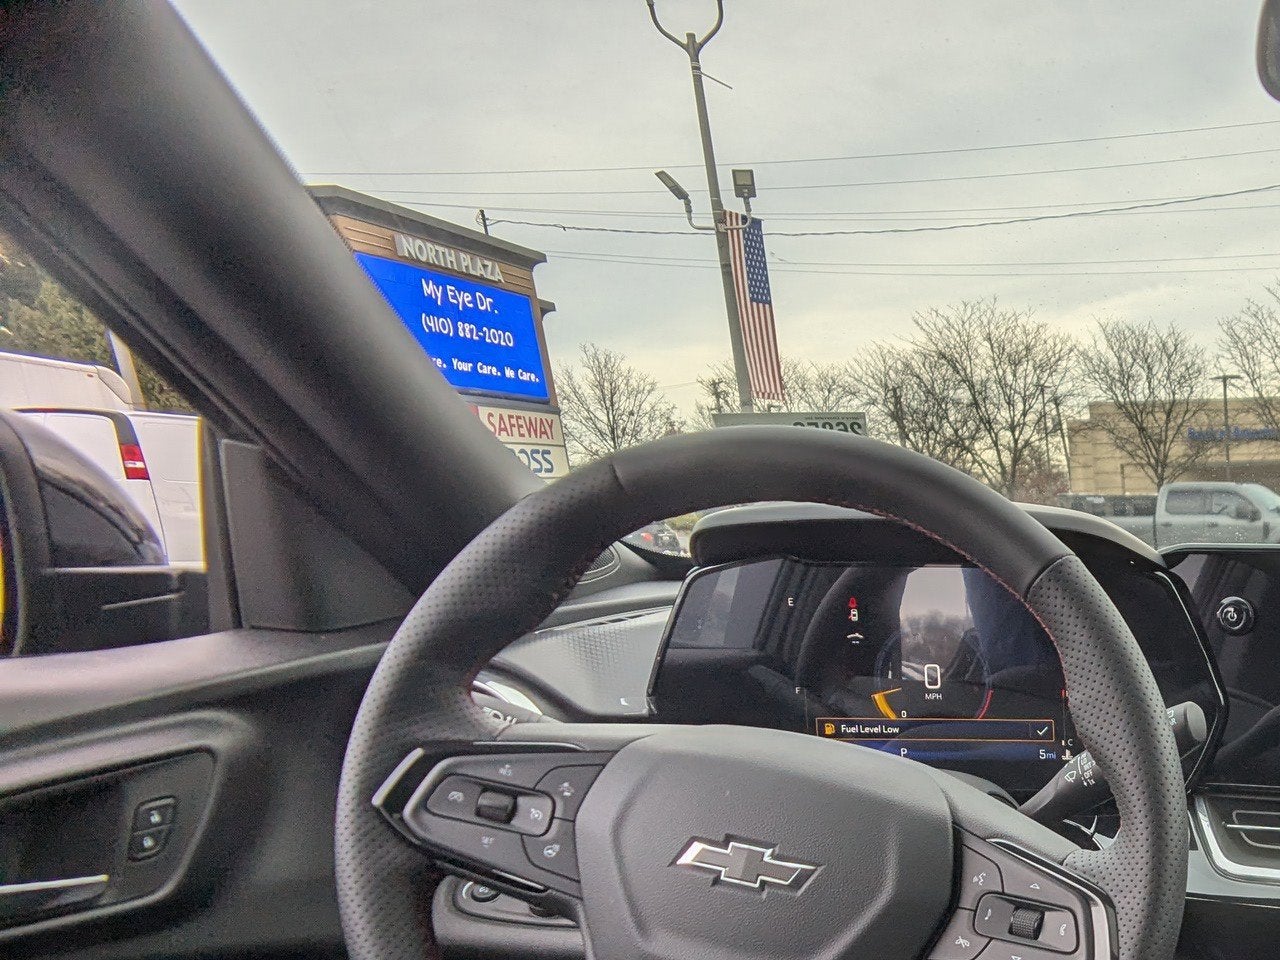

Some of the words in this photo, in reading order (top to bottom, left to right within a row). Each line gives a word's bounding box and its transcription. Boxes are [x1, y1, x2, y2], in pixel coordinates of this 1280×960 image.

[395, 233, 458, 271] NORTH
[459, 252, 505, 283] PLAZA
[422, 278, 442, 306] My
[446, 284, 474, 311] Eye
[475, 291, 498, 314] Dr.
[421, 312, 453, 337] (410)
[457, 321, 514, 347] 882-2020
[451, 357, 473, 372] Your
[477, 362, 501, 377] Care.
[504, 366, 515, 379] We
[517, 368, 539, 383] Care.
[486, 411, 555, 441] SAFEWAY
[510, 447, 554, 474] OSS
[924, 693, 943, 701] MPH
[841, 724, 859, 734] Fuel
[860, 724, 881, 734] Level
[882, 725, 900, 734] Low
[901, 747, 908, 757] P
